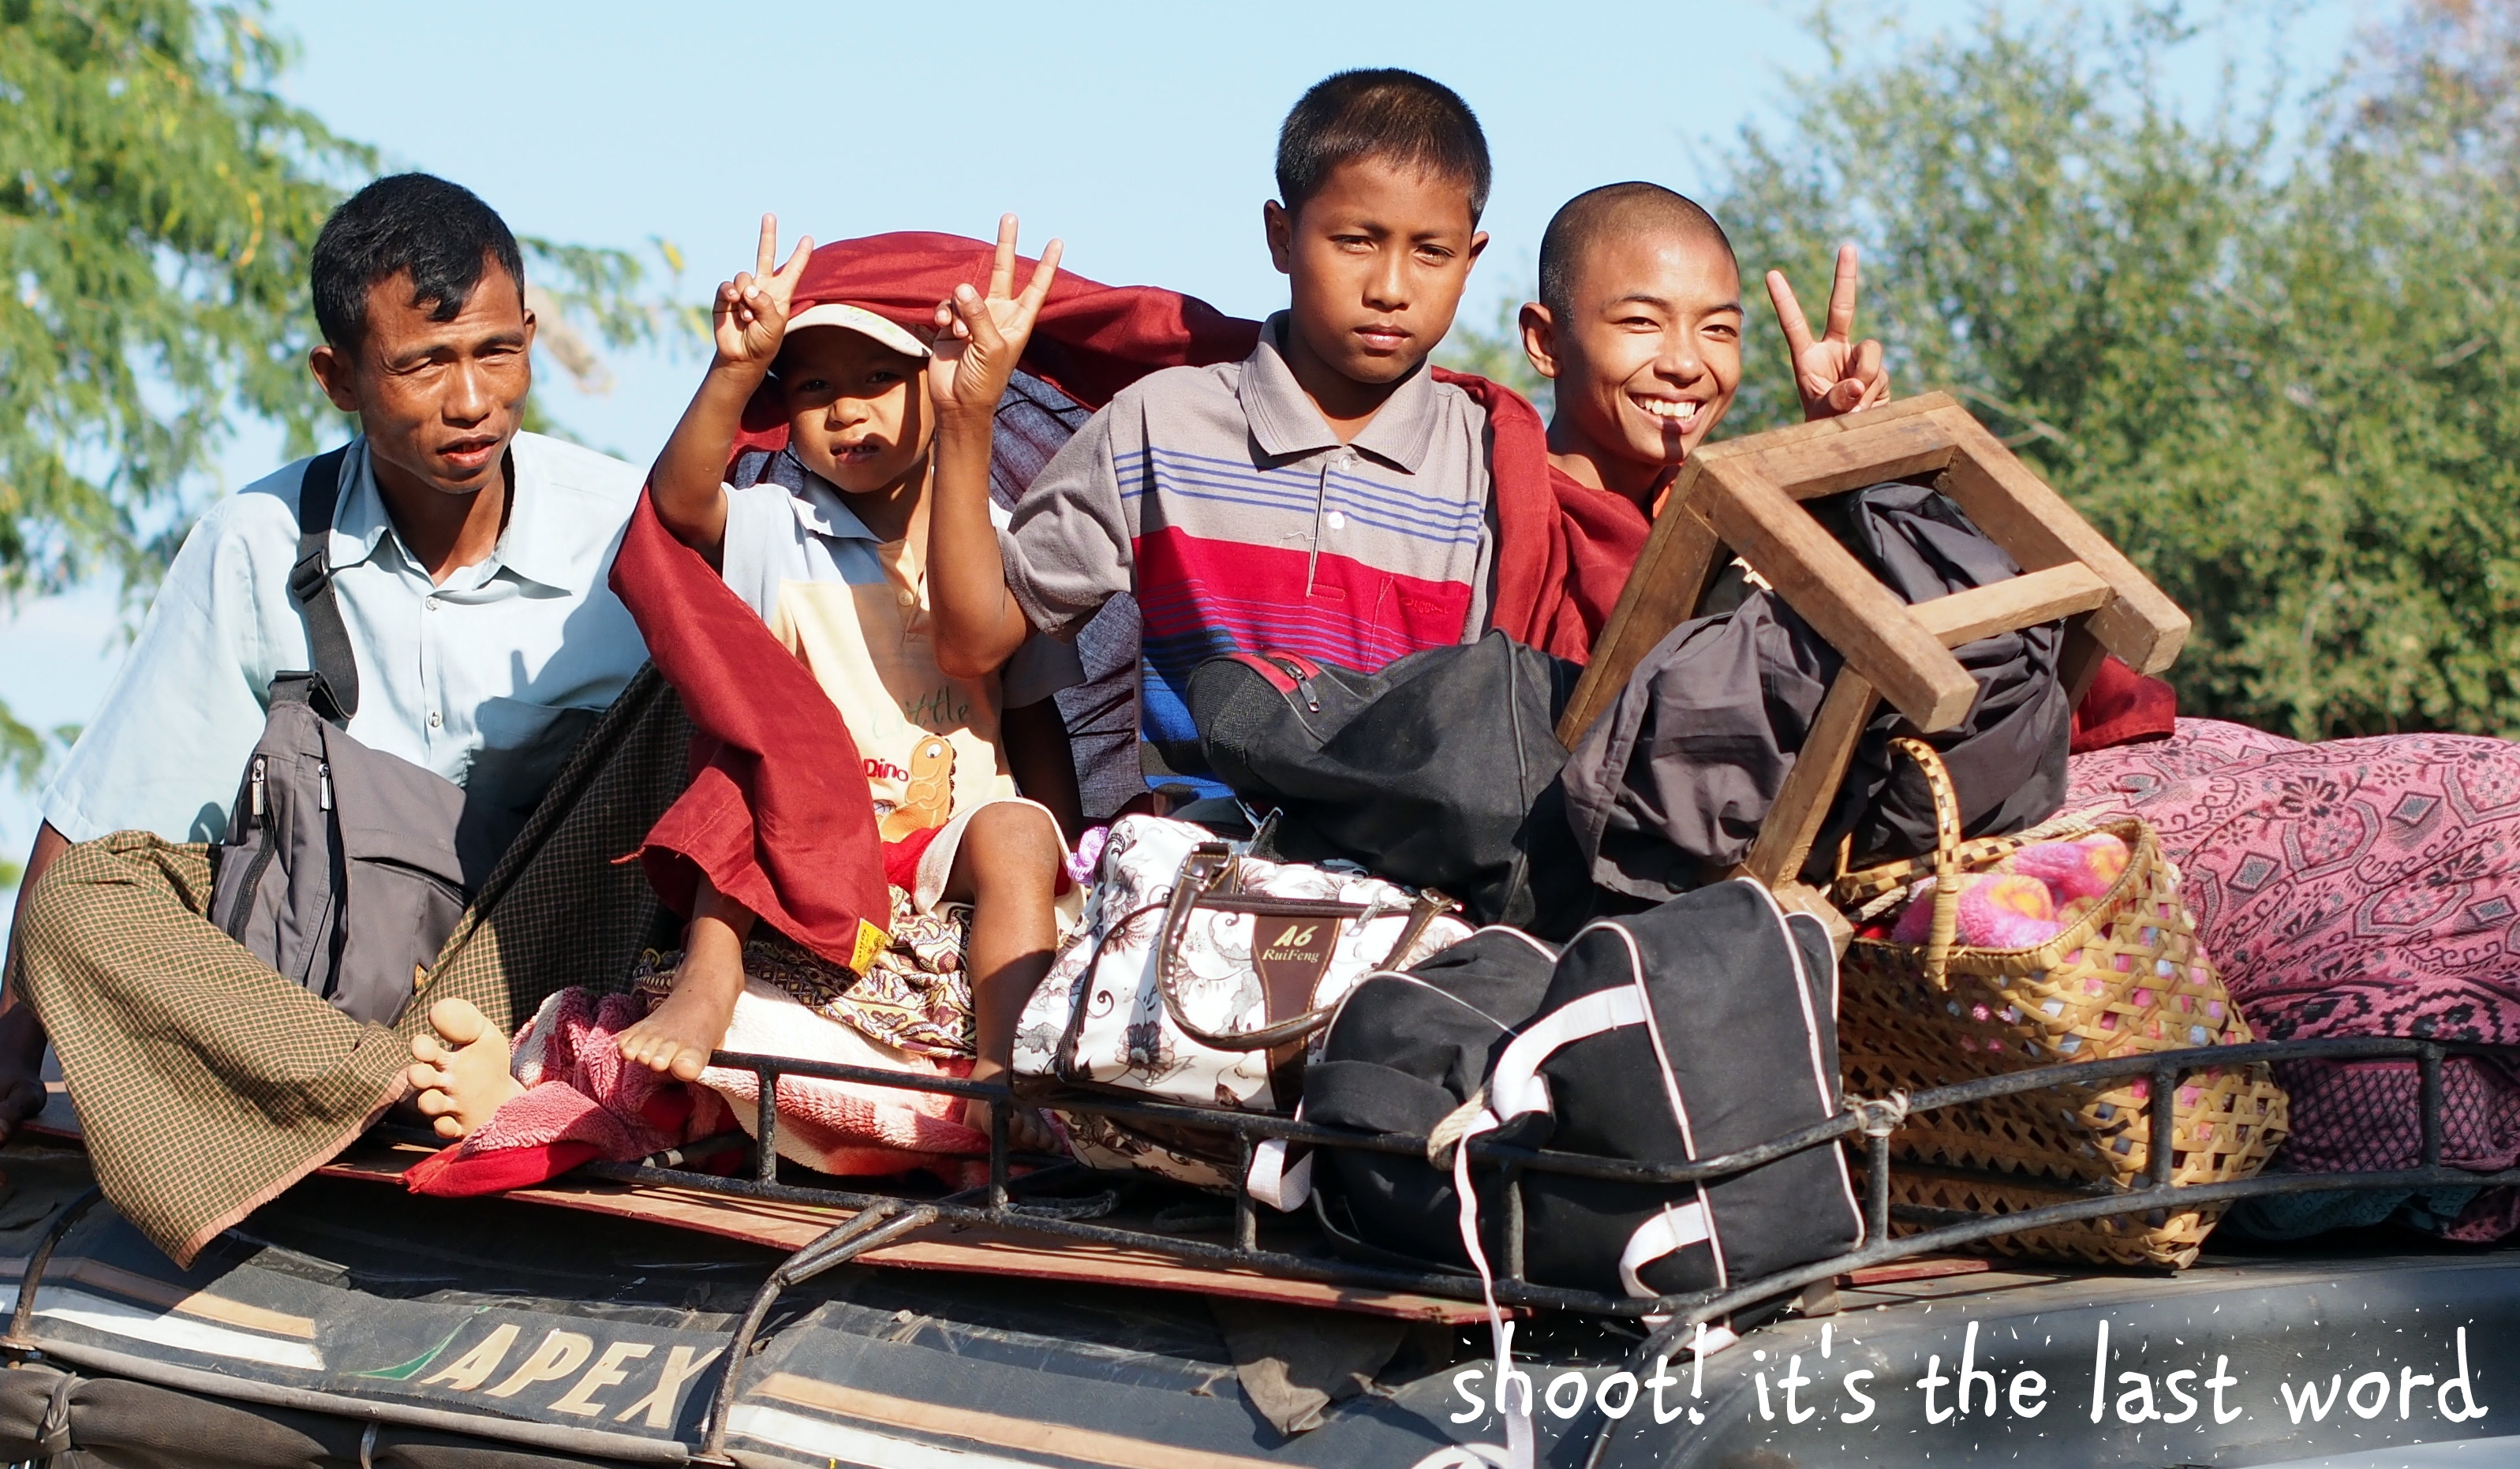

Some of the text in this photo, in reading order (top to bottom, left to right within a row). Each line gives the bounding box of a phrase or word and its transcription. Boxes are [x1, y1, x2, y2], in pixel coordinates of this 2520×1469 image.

[863, 757, 909, 782] Dino
[1273, 925, 1319, 947] A6
[1262, 948, 1320, 963] RuiFeng
[420, 1323, 725, 1430] APEX
